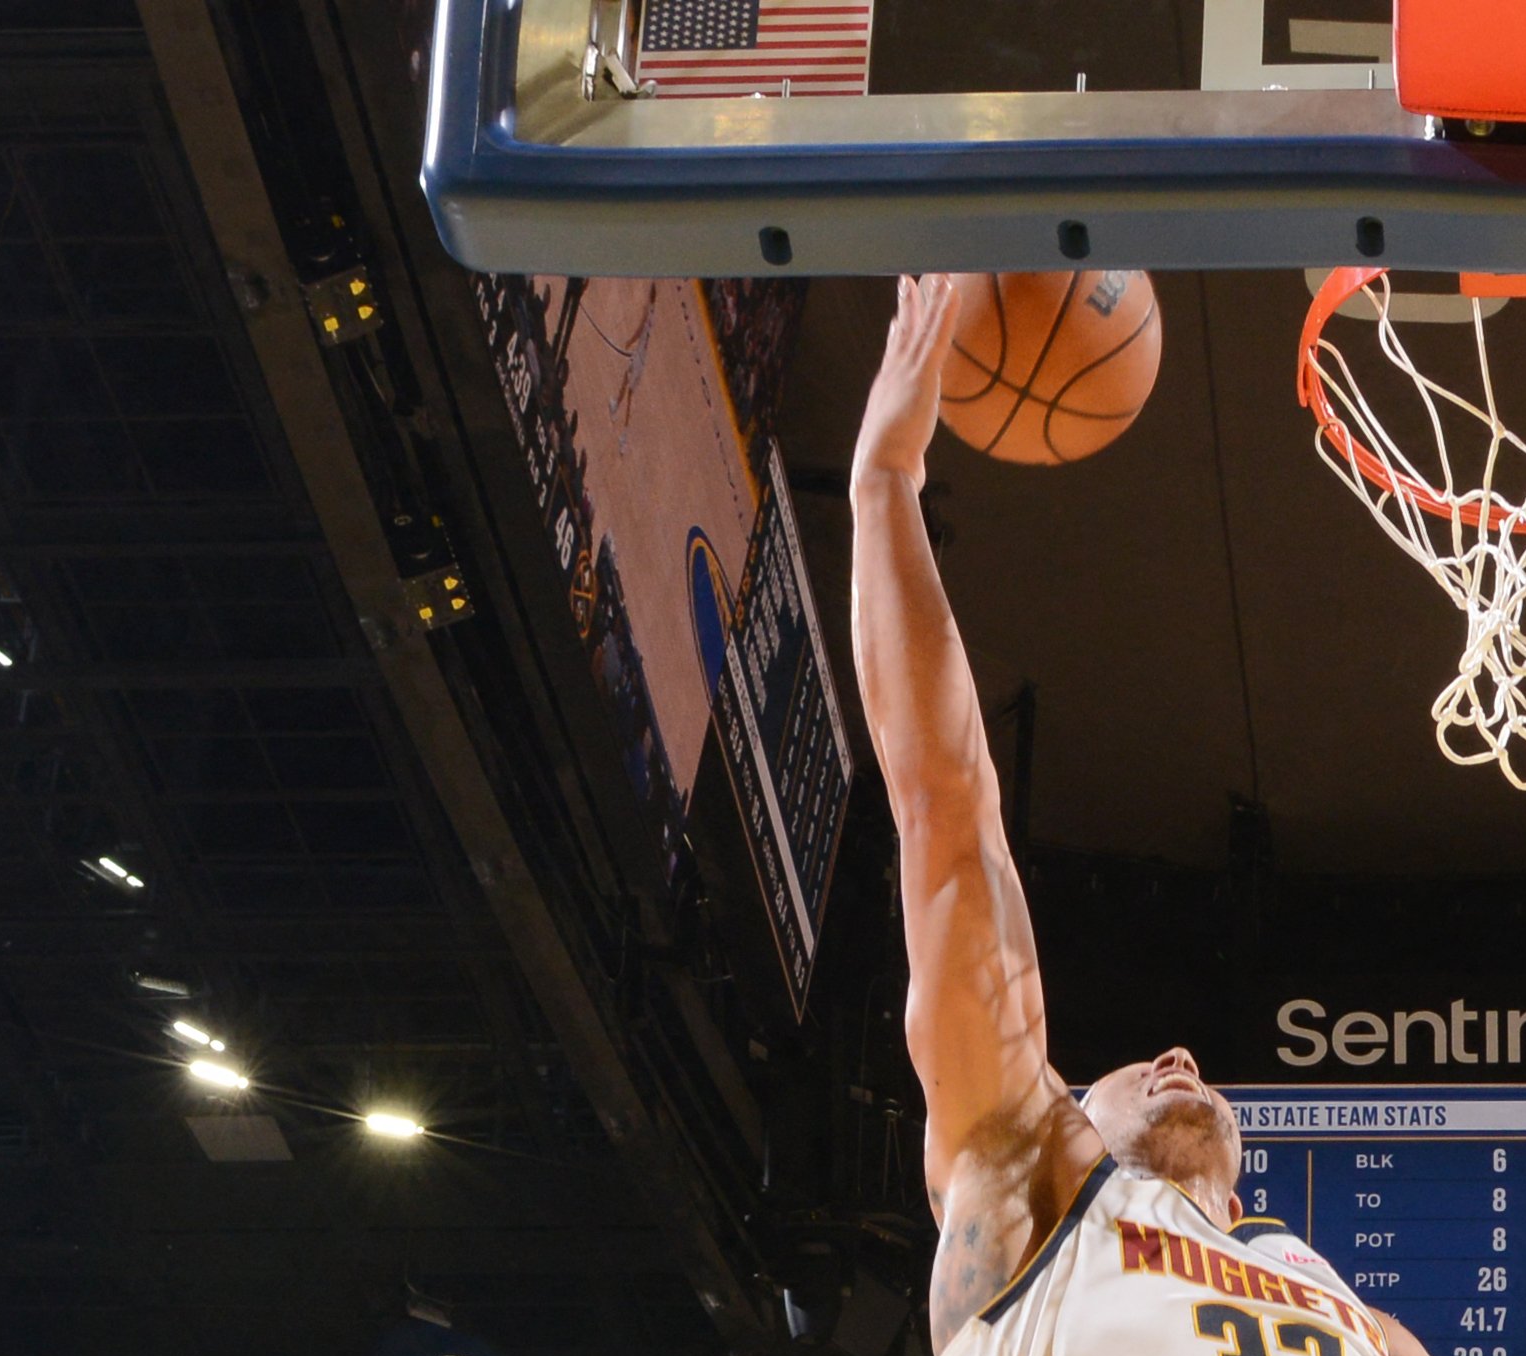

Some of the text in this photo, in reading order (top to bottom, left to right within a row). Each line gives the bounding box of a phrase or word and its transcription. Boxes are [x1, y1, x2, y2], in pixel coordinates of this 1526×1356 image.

[1259, 1105, 1319, 1126] STATE
[1325, 1105, 1379, 1126] TEAM
[1384, 1105, 1447, 1126] STATS
[1356, 1148, 1507, 1174] BLK 6
[1254, 1188, 1268, 1214] 3
[1356, 1188, 1507, 1214] TO 8
[1356, 1227, 1507, 1253] POT 8
[1356, 1266, 1508, 1293] PITP 26
[1460, 1306, 1508, 1333] 41.7
